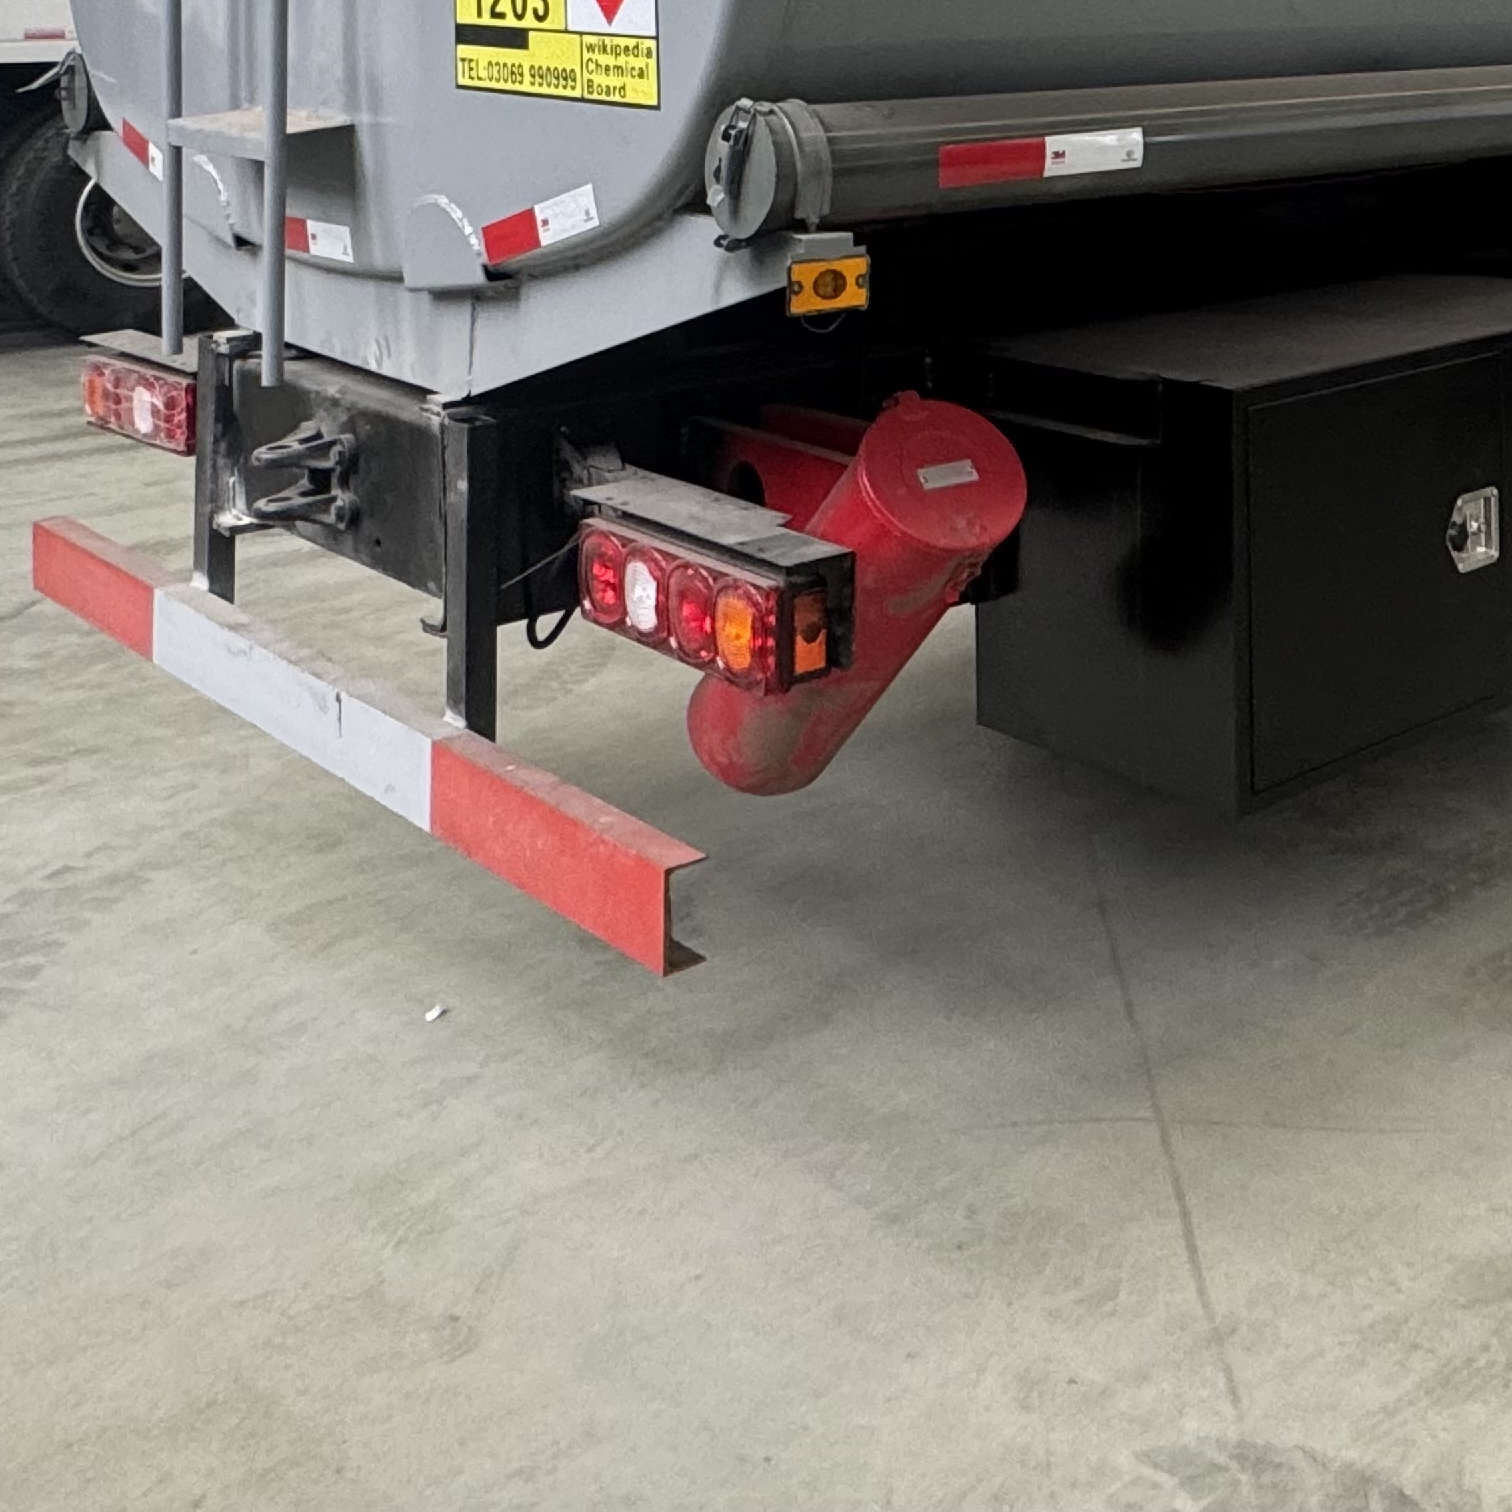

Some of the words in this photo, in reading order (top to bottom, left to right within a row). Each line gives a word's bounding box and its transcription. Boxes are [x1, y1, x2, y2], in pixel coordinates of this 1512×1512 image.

[585, 38, 653, 59] wikipedia
[529, 65, 577, 91] 990999
[585, 58, 650, 80] Chemical
[586, 79, 626, 99] Board
